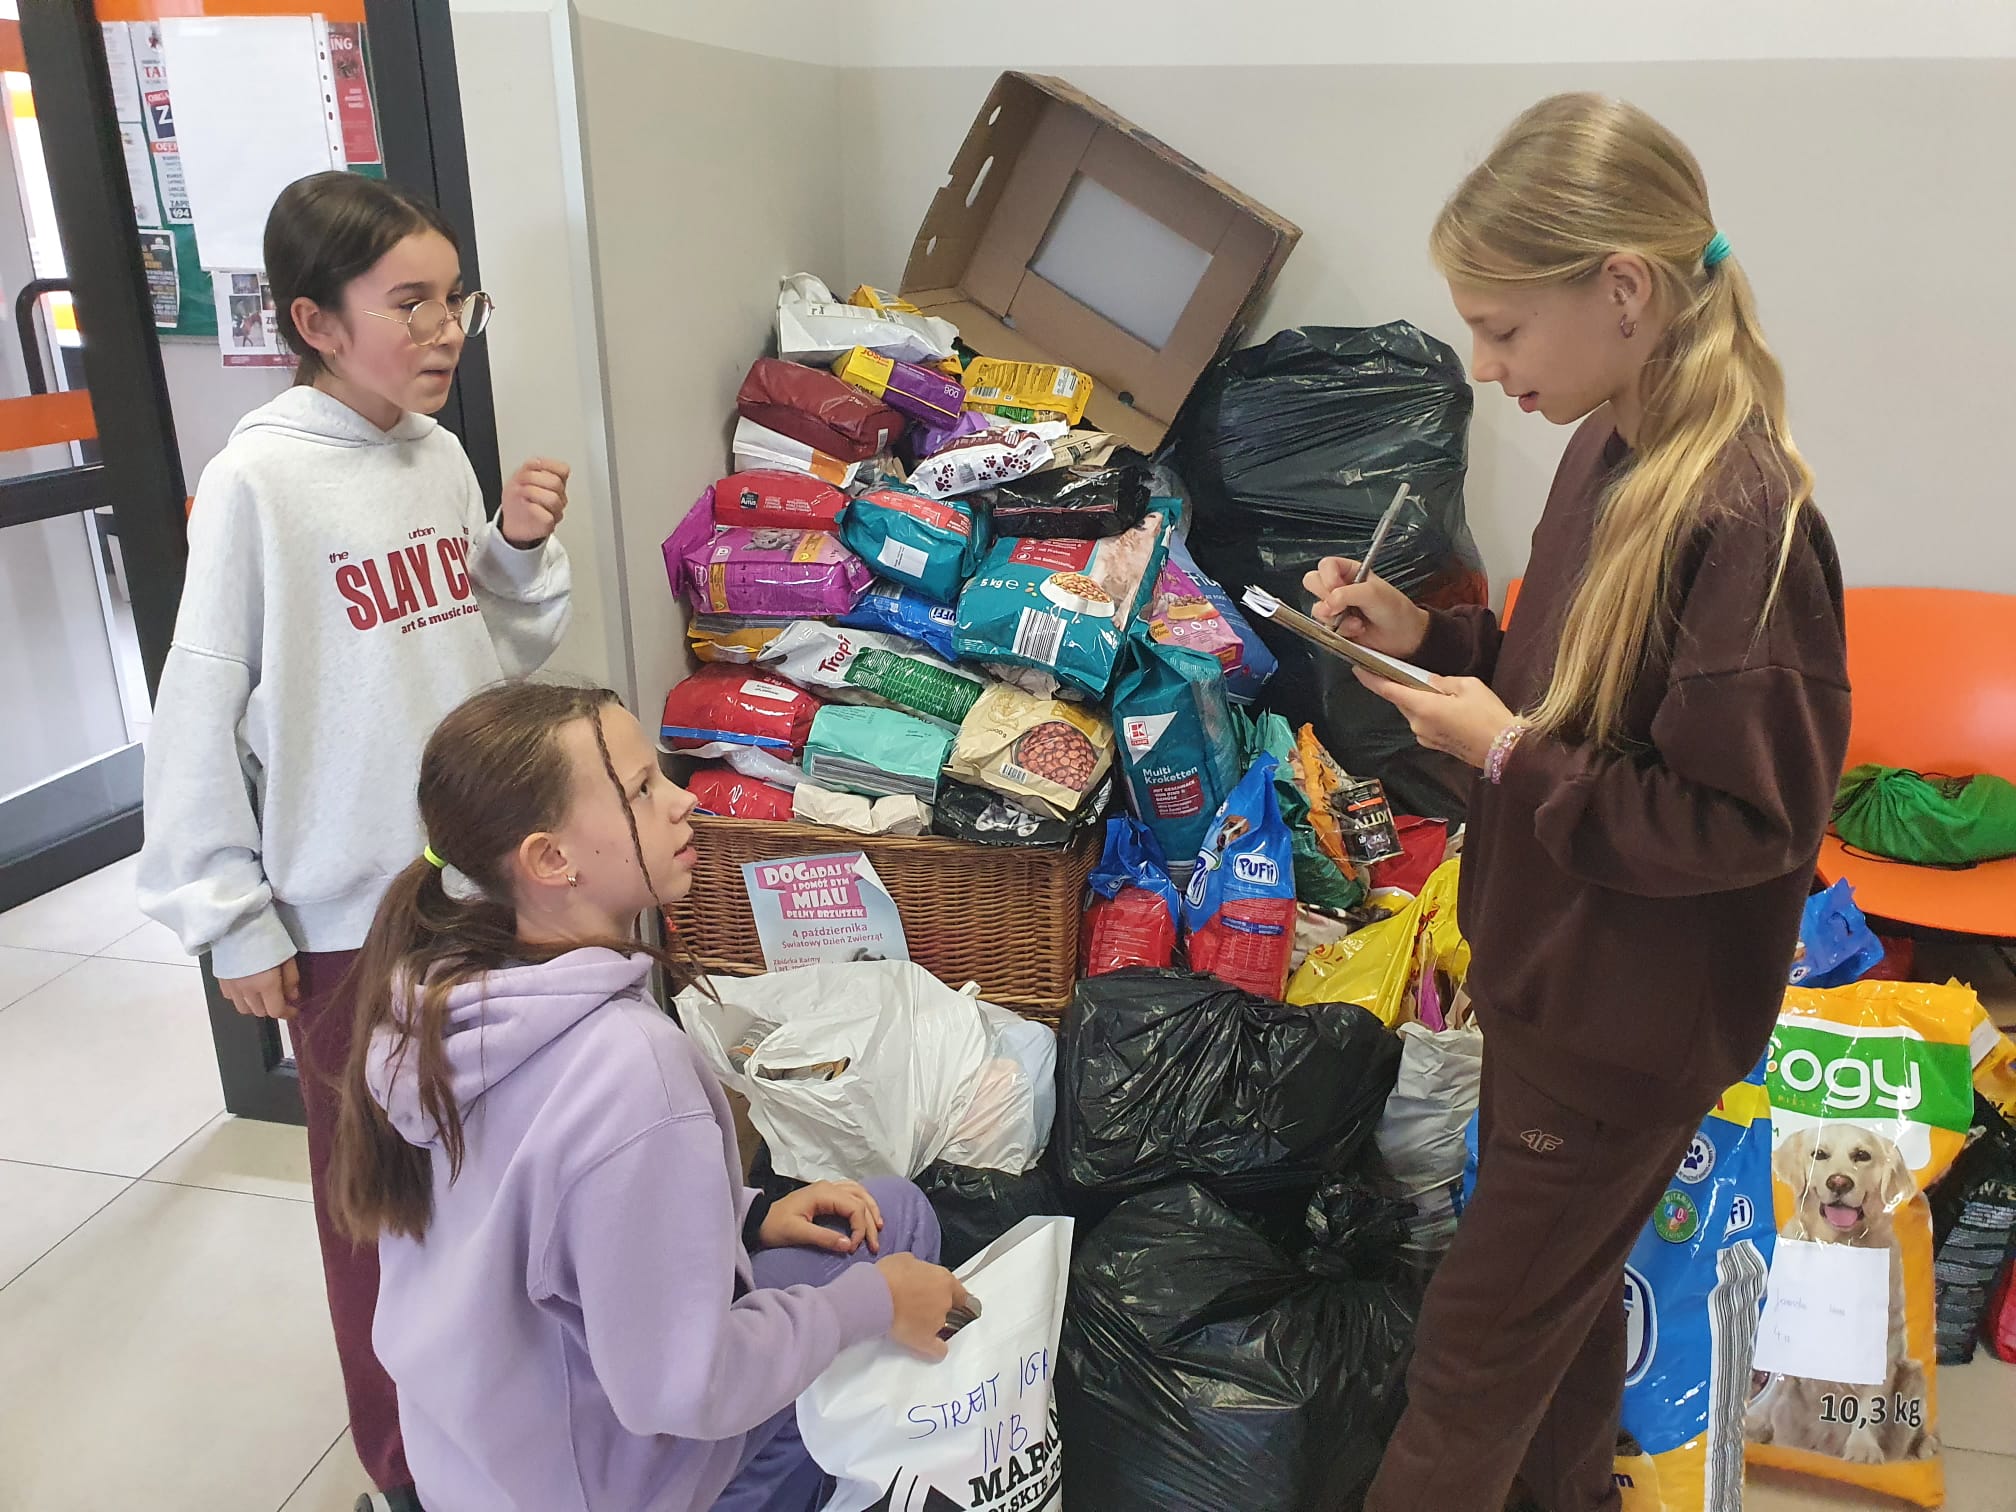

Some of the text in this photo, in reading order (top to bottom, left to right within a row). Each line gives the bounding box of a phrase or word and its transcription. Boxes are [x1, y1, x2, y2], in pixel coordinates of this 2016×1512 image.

[408, 526, 436, 540] urban
[328, 551, 349, 564] the
[335, 543, 439, 631] SLAY
[980, 578, 988, 587] 5
[989, 578, 1003, 590] kg
[401, 620, 416, 634] art
[418, 617, 427, 629] &
[429, 607, 461, 625] music
[818, 634, 853, 674] Tropi
[1142, 765, 1171, 778] Multi
[1144, 766, 1198, 784] Kroketten
[791, 887, 849, 910] MIAU
[792, 923, 868, 940] 4 października
[823, 935, 846, 946] Dzień
[847, 932, 884, 945] Zwierząt
[1520, 1129, 1564, 1152] 4F
[907, 1371, 1000, 1440] STREIT
[1820, 1392, 1922, 1430] 10,3 kg
[1009, 1413, 1029, 1451] B
